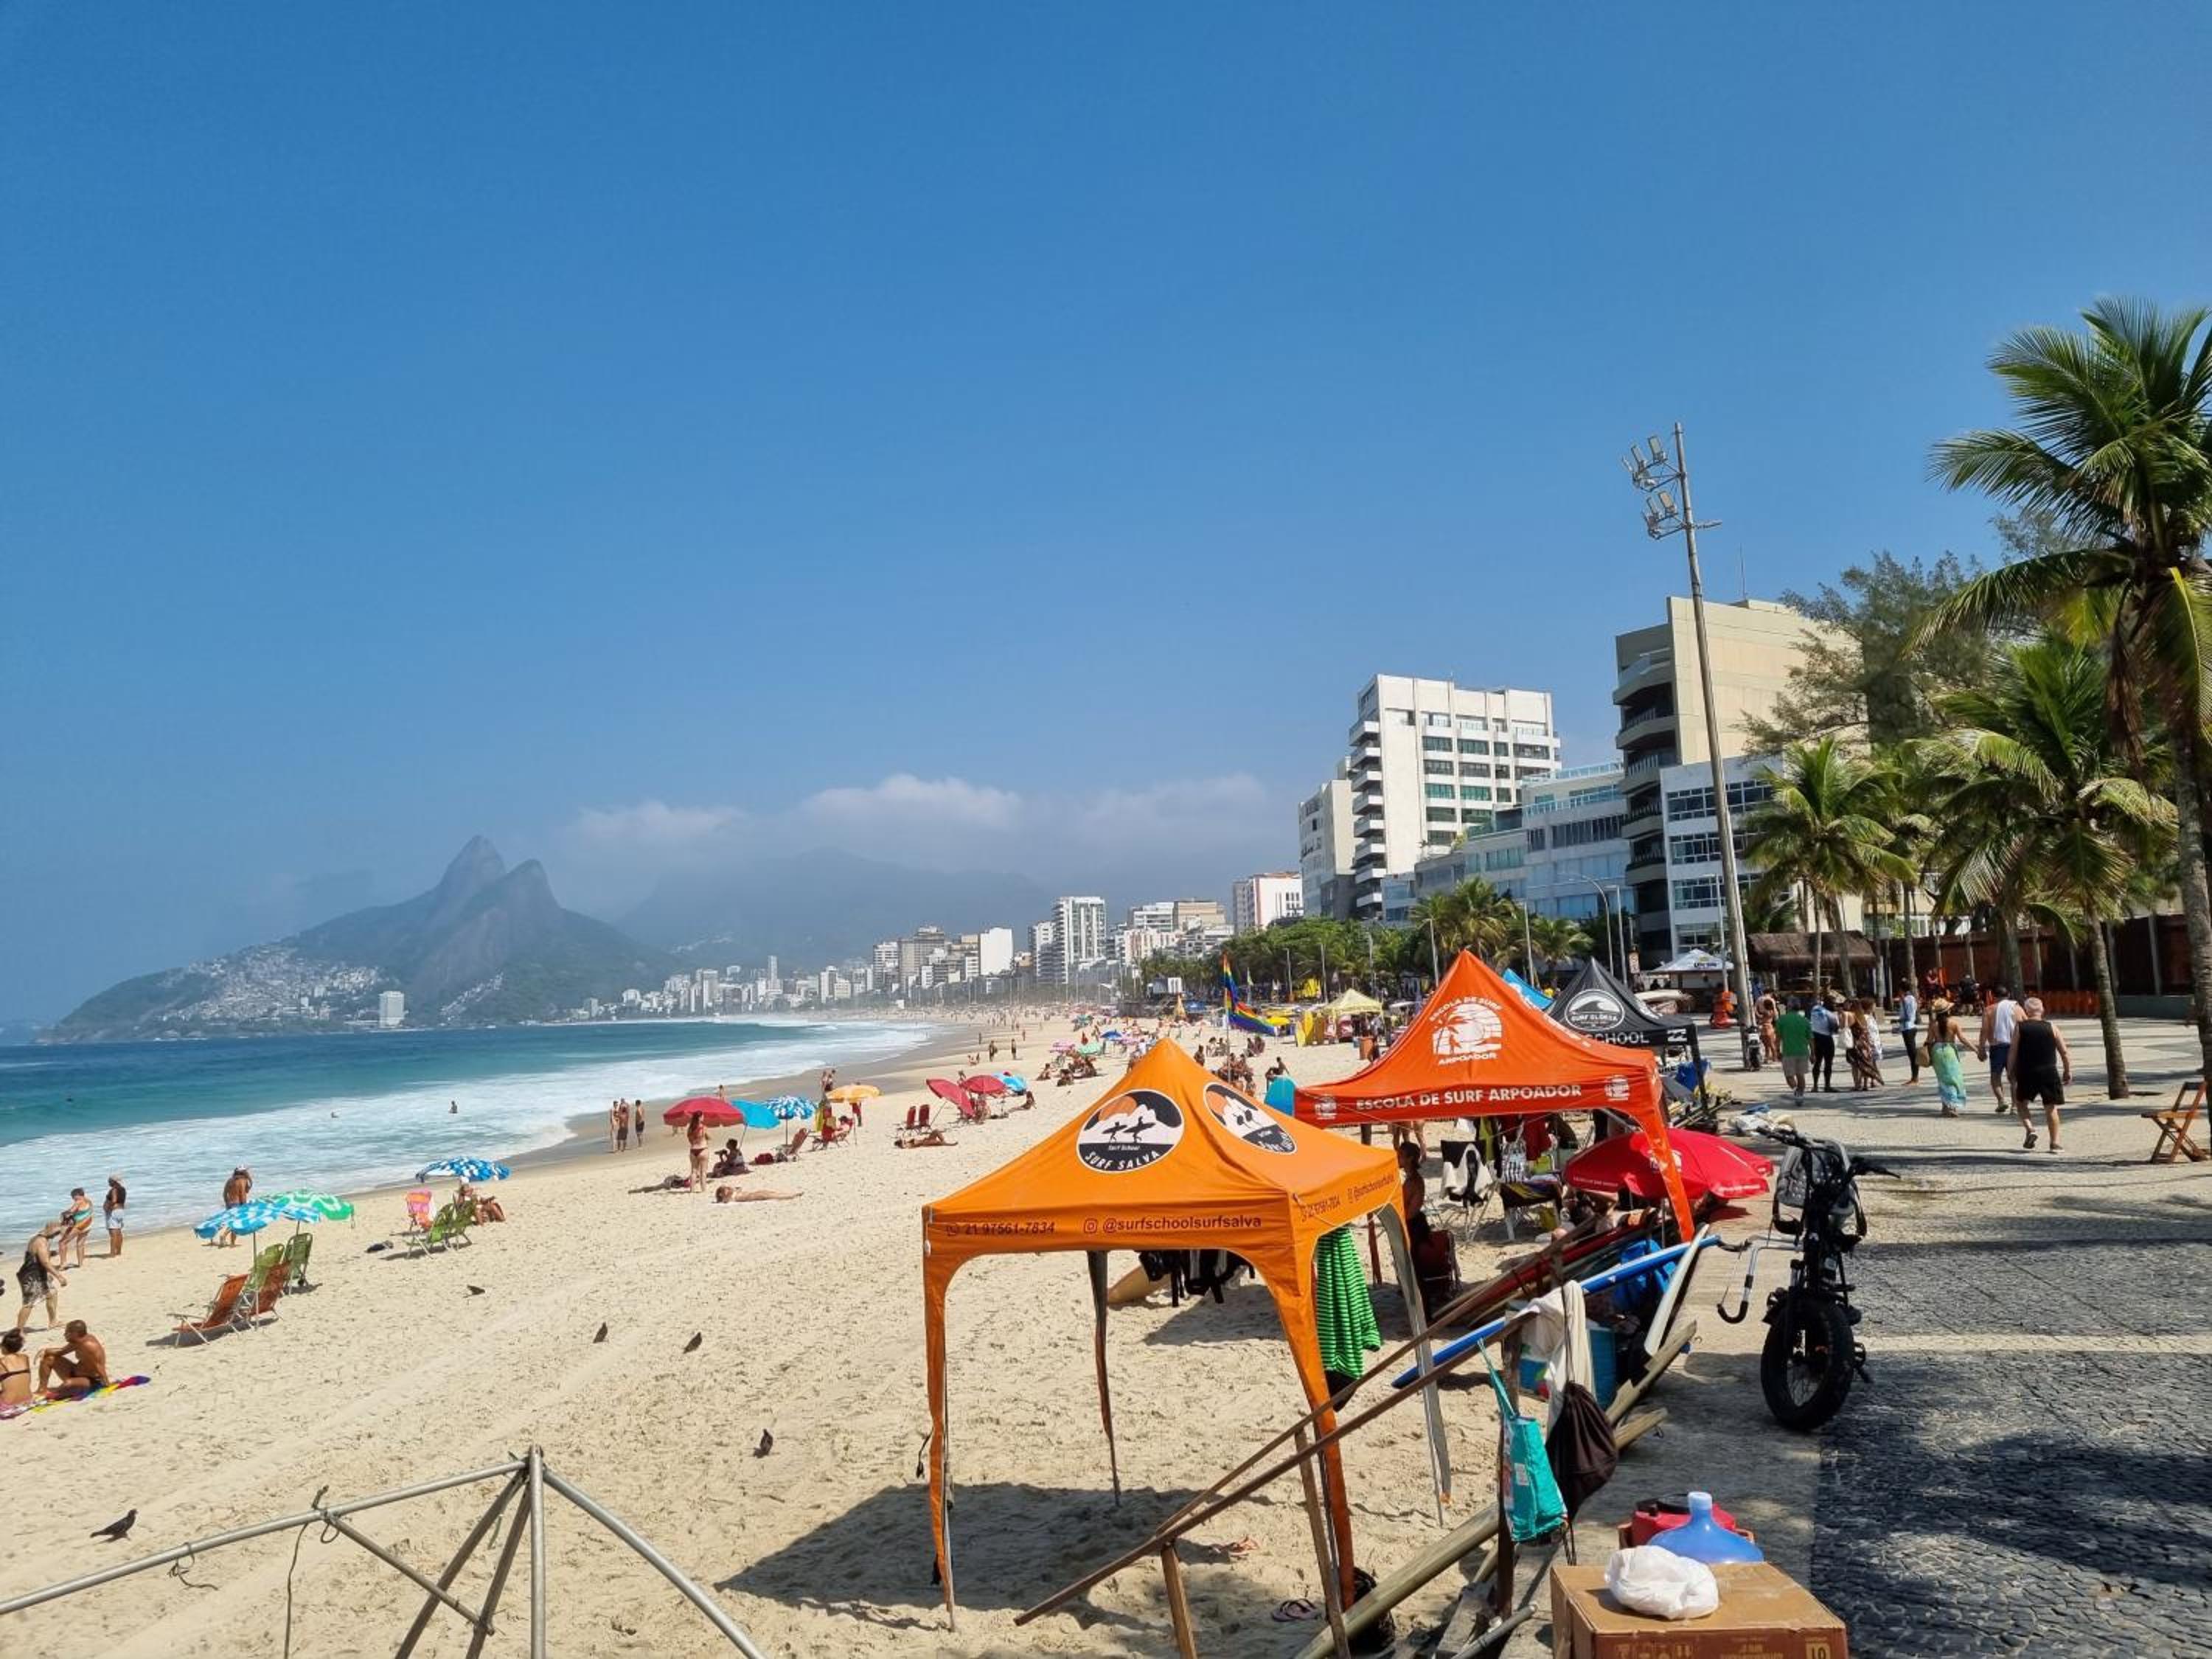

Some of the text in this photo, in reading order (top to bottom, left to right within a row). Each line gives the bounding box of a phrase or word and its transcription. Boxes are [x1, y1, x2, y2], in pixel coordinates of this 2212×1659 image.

[1356, 1084, 1582, 1110] ESCOLA DE SURF ARPOADOR
[1085, 1150, 1161, 1170] SURF SALVA
[1103, 1214, 1262, 1234] @surfschoolsurfsalva
